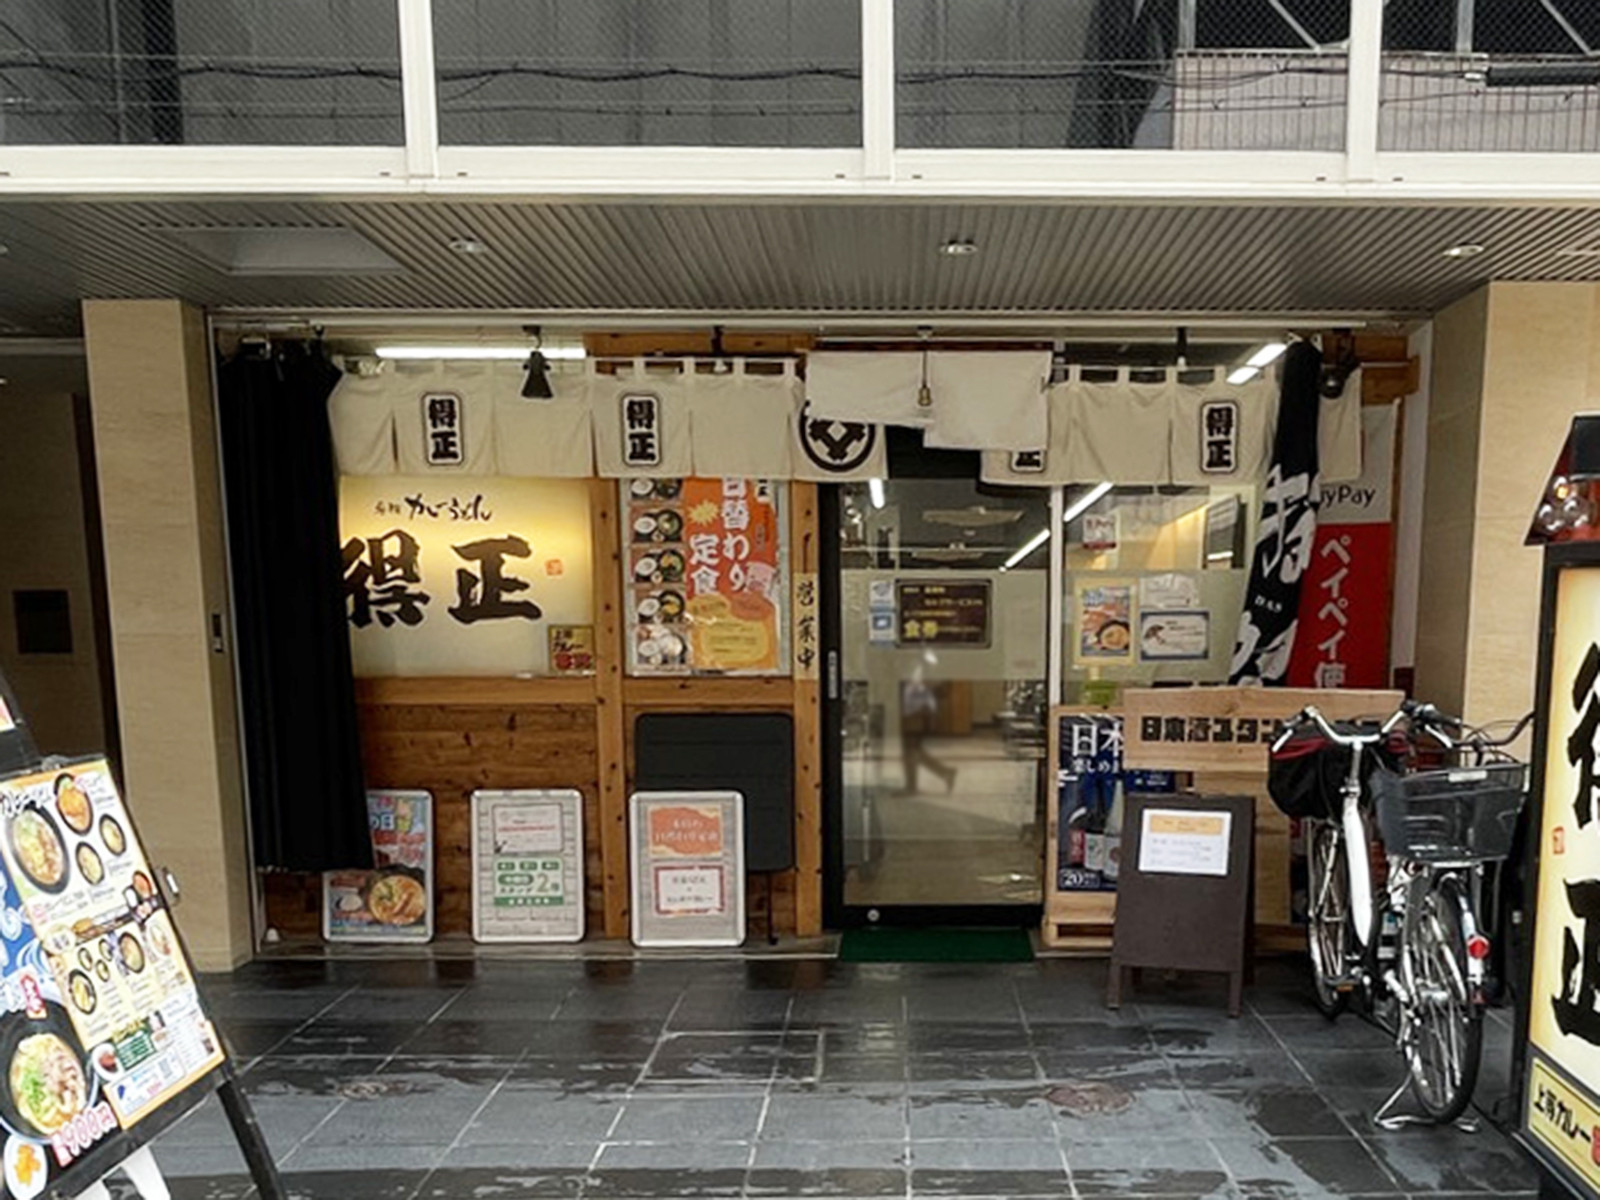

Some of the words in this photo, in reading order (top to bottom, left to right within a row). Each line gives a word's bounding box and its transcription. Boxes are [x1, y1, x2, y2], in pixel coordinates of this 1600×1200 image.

[428, 397, 460, 460] 得正
[626, 399, 657, 461] 得正
[1206, 406, 1233, 468] 得正
[1319, 485, 1376, 507] yPay
[340, 529, 542, 627] 得正
[690, 533, 721, 596] 定食
